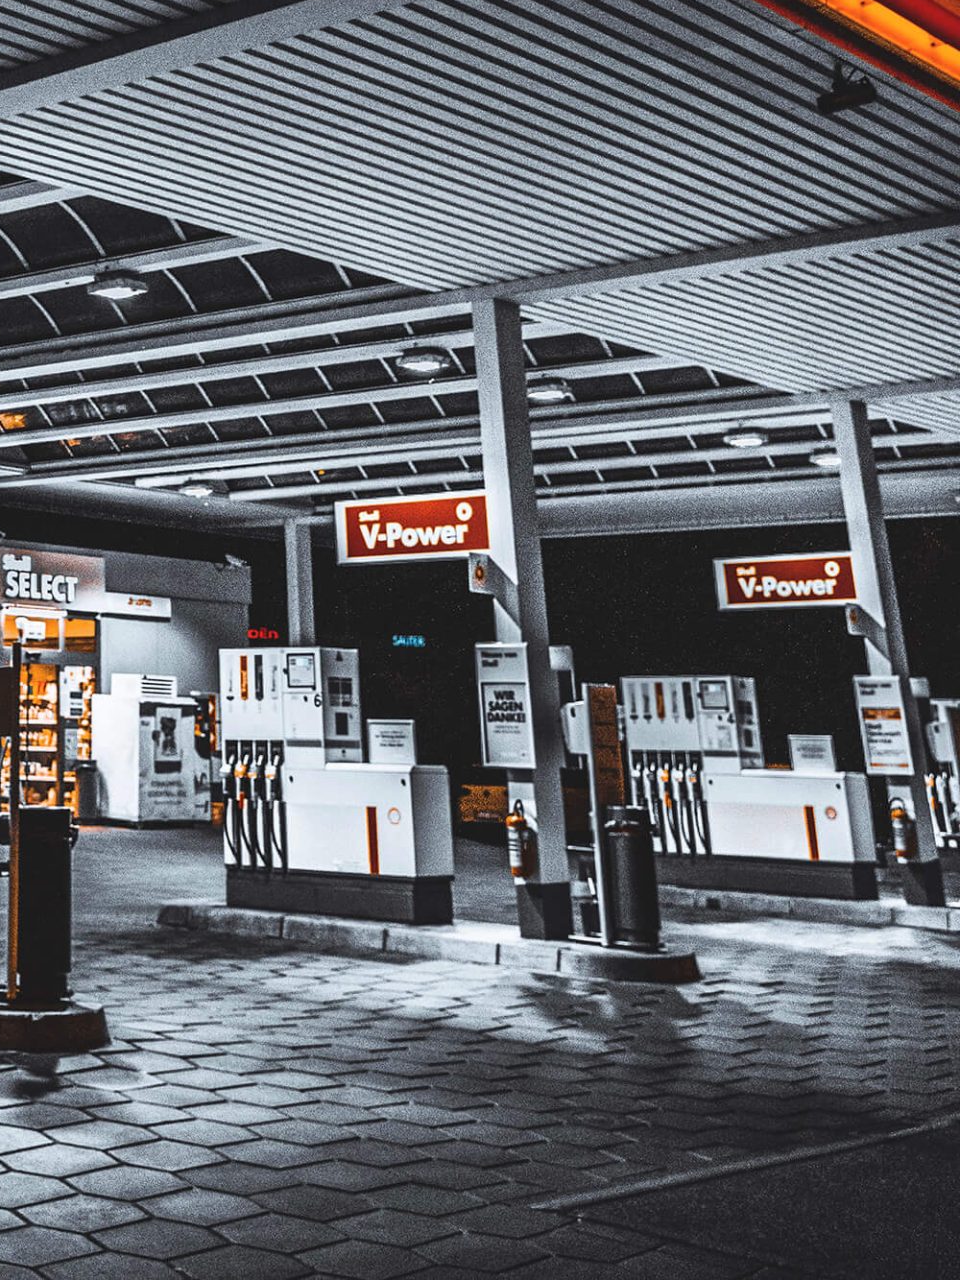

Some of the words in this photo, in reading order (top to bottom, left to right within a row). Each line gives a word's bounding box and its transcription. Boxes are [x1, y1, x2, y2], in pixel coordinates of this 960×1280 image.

[359, 522, 469, 550] V-Power
[5, 571, 78, 603] SELECT
[737, 576, 838, 599] V-Power
[314, 694, 323, 707] 6
[494, 690, 515, 700] WIR
[488, 701, 523, 712] SAGEN
[487, 712, 526, 723] DANKE!
